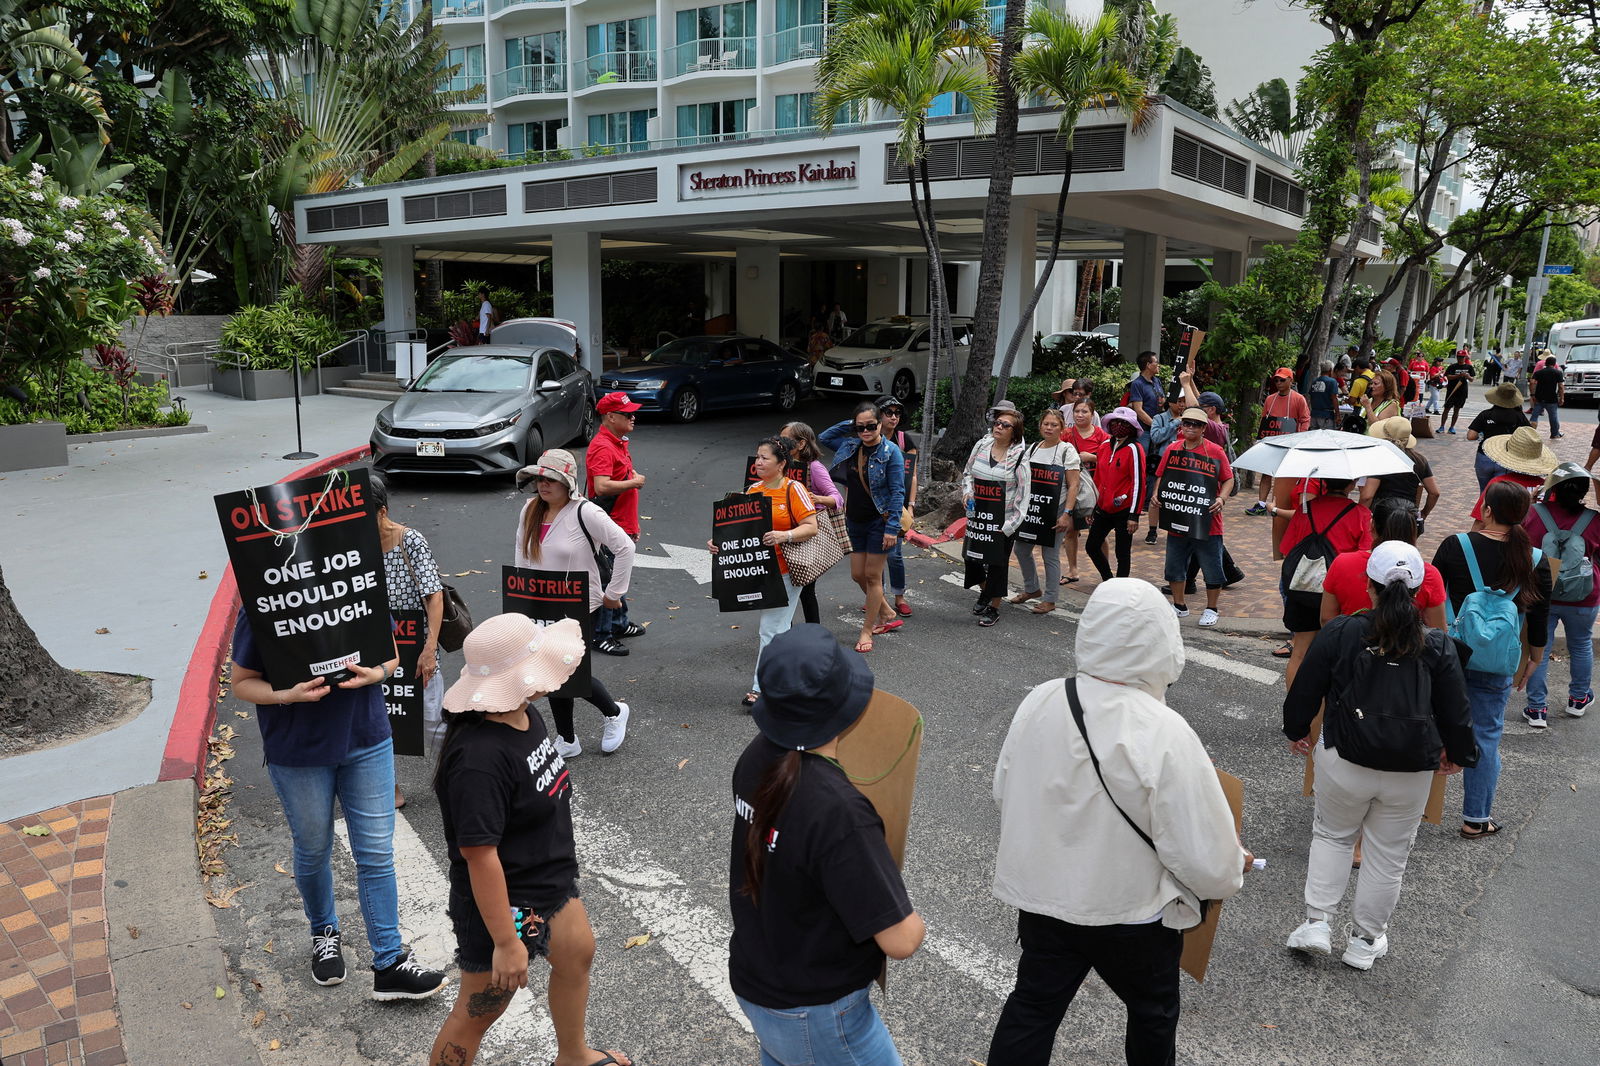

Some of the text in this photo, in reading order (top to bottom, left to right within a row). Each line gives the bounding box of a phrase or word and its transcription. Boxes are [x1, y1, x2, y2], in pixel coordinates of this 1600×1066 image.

[690, 160, 856, 190] Sheraton Princess Kaiulani
[1270, 420, 1281, 429] ON
[1169, 455, 1216, 473] ON STRIKE
[975, 484, 1002, 497] TRIKE
[1167, 481, 1207, 494] ONE JOB
[1029, 493, 1053, 504] PECT
[1160, 490, 1211, 506] SHOULD BE
[231, 484, 364, 530] ON STRIKE
[716, 500, 762, 520] ON STRIKE
[1028, 504, 1040, 513] UR
[1164, 501, 1203, 516] ENOUGH.
[977, 511, 994, 521] JOB
[1024, 514, 1045, 525] ORK.
[986, 523, 1000, 532] BE
[721, 537, 760, 551] ONE JOB
[718, 549, 771, 566] SHOULD BE
[264, 550, 361, 585] ONE JOB
[723, 565, 768, 579] ENOUGH.
[256, 571, 378, 613] SHOULD BE
[507, 576, 582, 595] ON STRIKE
[273, 600, 373, 637] ENOUGH.
[393, 685, 415, 697] BE
[536, 768, 555, 792] OUR
